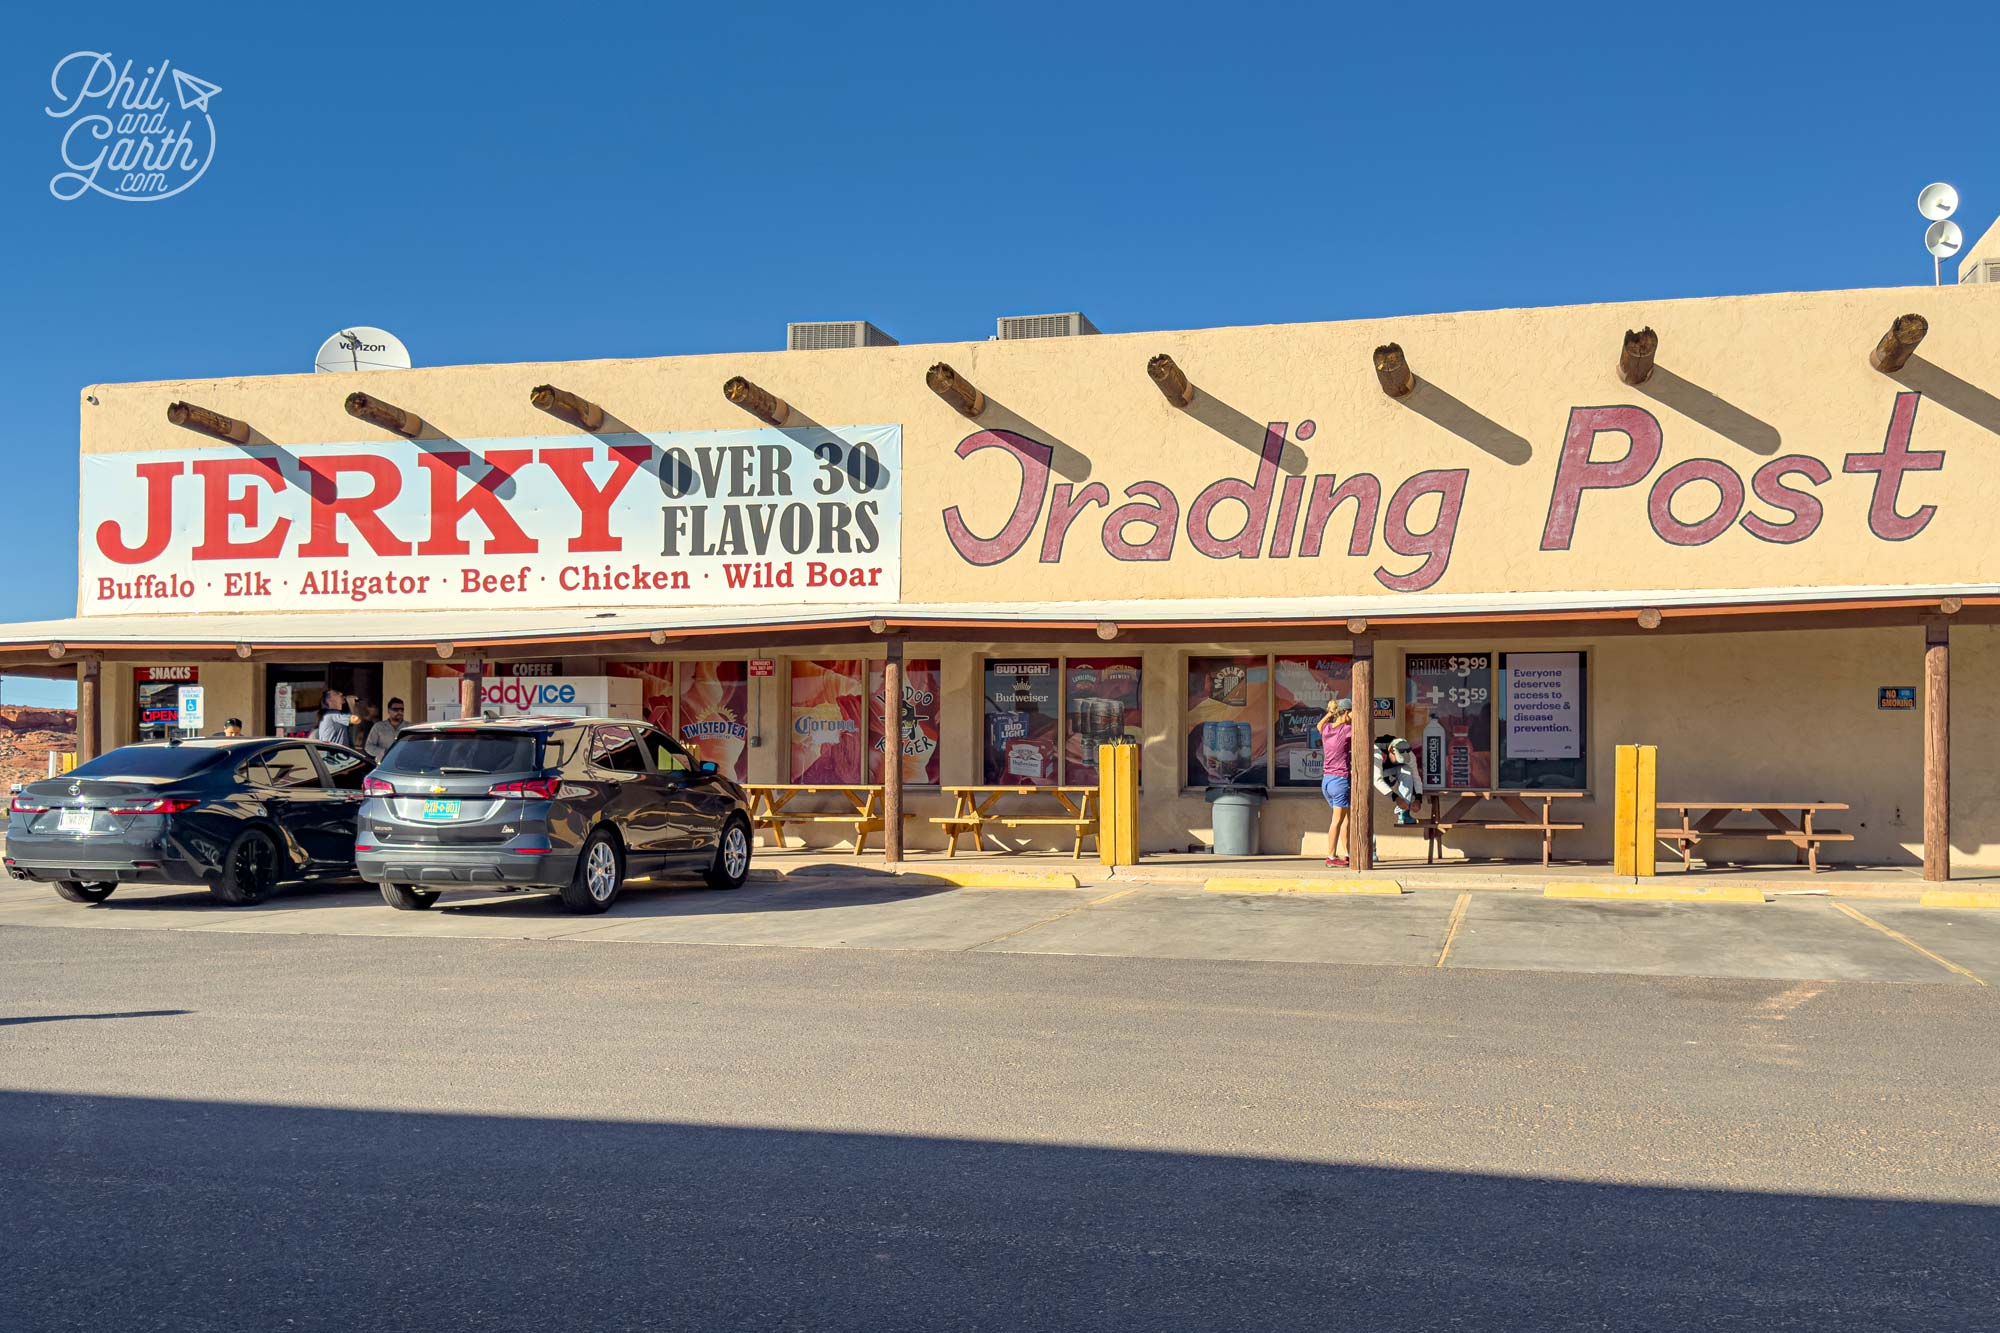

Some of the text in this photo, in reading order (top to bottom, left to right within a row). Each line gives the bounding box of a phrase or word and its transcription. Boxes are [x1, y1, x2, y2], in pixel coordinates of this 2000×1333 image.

[339, 342, 386, 352] veizon
[659, 441, 880, 501] OVER 30
[942, 391, 1946, 592] Trading Post
[96, 445, 652, 565] JERKY
[660, 500, 880, 557] FLAVORS
[97, 561, 882, 601] Buffalo Elk Alligator Beef Chicken Wild Boar
[512, 663, 553, 676] COFFEE
[996, 665, 1048, 674] BUD LIGHT
[1409, 658, 1447, 675] PRIME
[149, 666, 191, 680] SNACKS
[1513, 669, 1562, 679] Everyone
[1513, 680, 1561, 688] deserves
[995, 692, 1049, 702] Budweiser
[1513, 691, 1562, 699] access to
[1886, 690, 1897, 698] NO
[1513, 701, 1570, 711] overdose &
[1882, 699, 1913, 707] SMOKING
[143, 710, 178, 722] OPEN
[1513, 712, 1553, 721] disease
[682, 721, 747, 739] TWISTED TEA
[795, 716, 859, 736] Corona
[1004, 723, 1023, 731] BUD
[1513, 723, 1572, 734] prevention.
[1001, 730, 1025, 738] LIGHT
[1429, 737, 1438, 773] essentia
